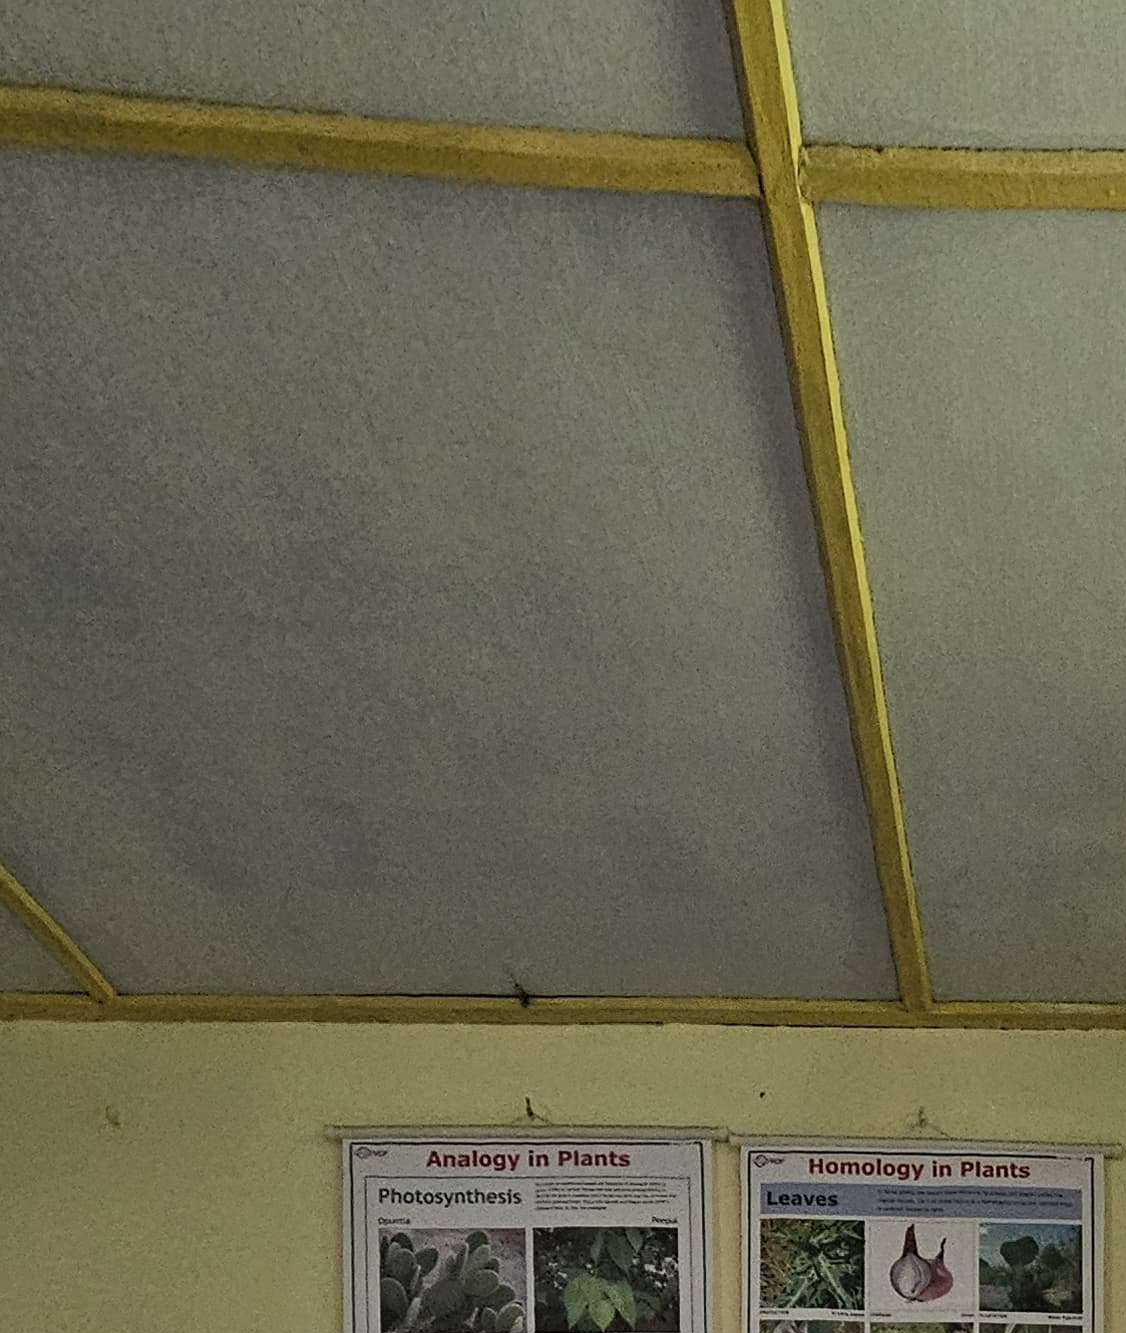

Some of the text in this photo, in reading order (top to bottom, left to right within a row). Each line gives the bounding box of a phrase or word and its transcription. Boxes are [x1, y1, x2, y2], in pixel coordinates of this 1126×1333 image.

[426, 1150, 631, 1170] Analogy in Plants
[808, 1157, 1031, 1181] Homology in Plants
[378, 1188, 522, 1208] Photosynthesis
[766, 1192, 839, 1206] Leaves
